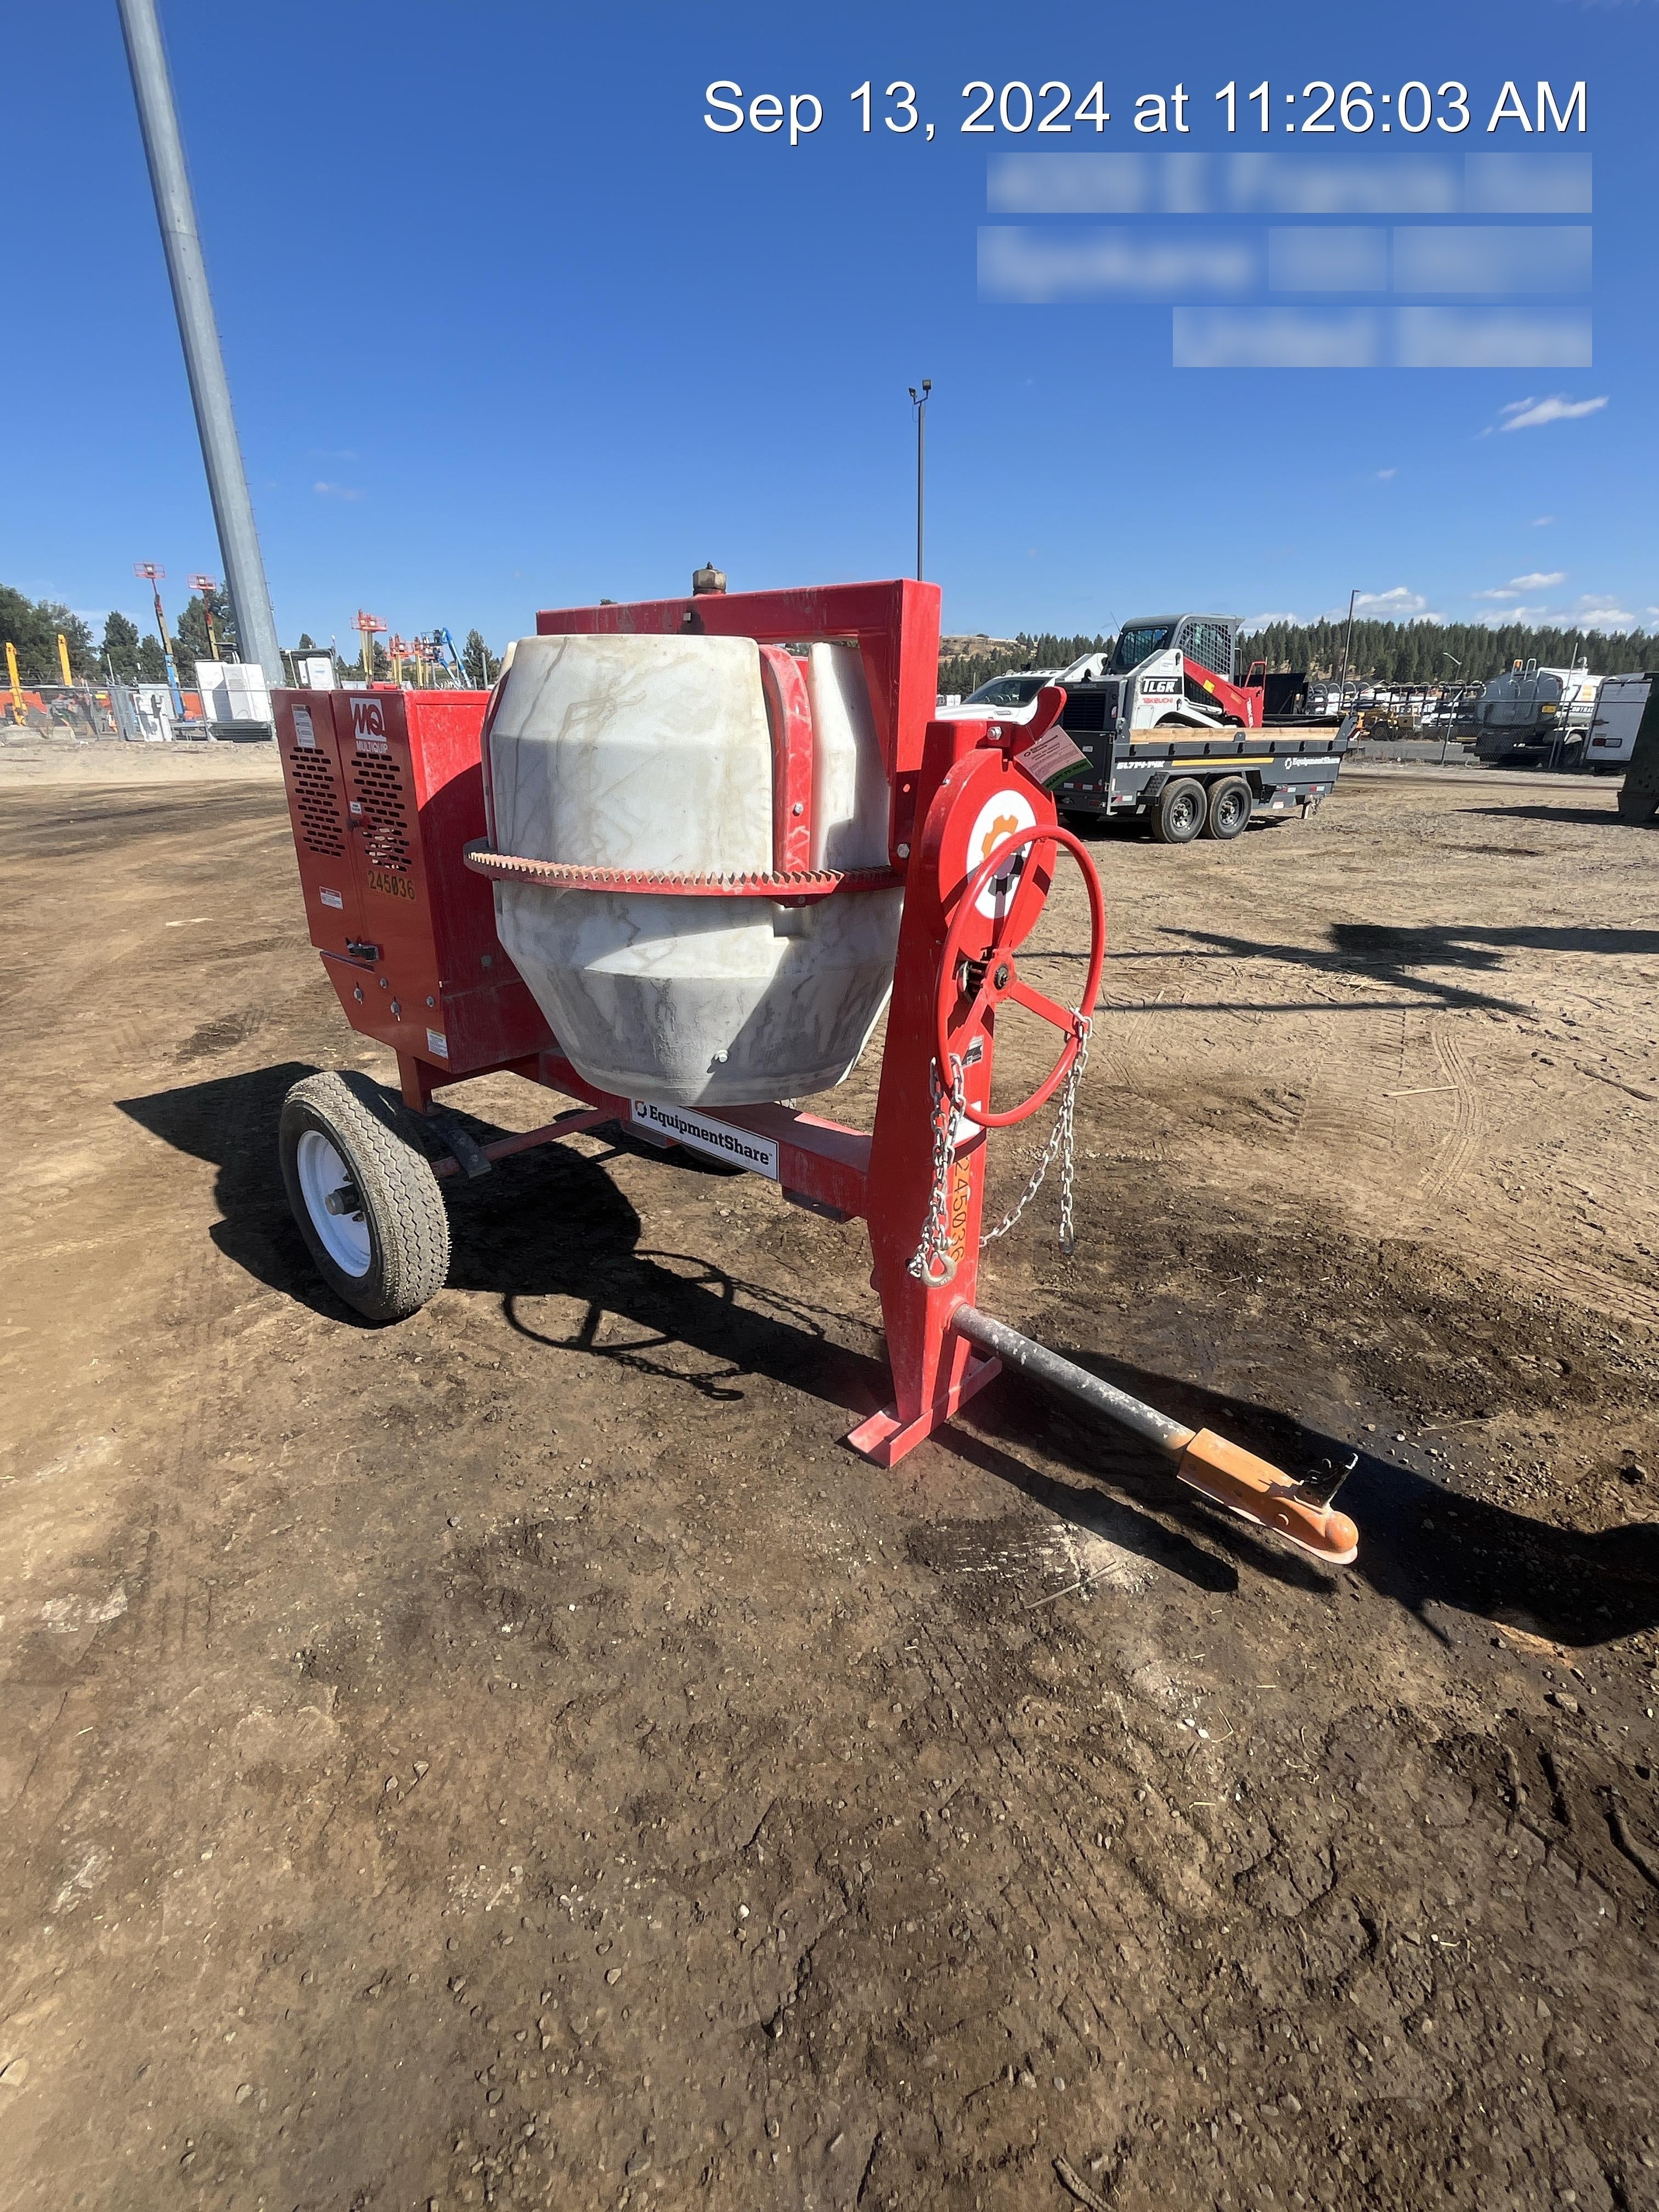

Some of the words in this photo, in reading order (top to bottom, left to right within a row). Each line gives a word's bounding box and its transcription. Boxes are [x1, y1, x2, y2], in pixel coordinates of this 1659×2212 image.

[1143, 679, 1178, 692] TL6R
[351, 701, 387, 739] MQ
[356, 741, 388, 754] MULTIQUIP
[1046, 774, 1063, 788] READY
[368, 870, 415, 900] 245036
[649, 1104, 769, 1165] EquipmentShare
[951, 1156, 970, 1263] 245036
